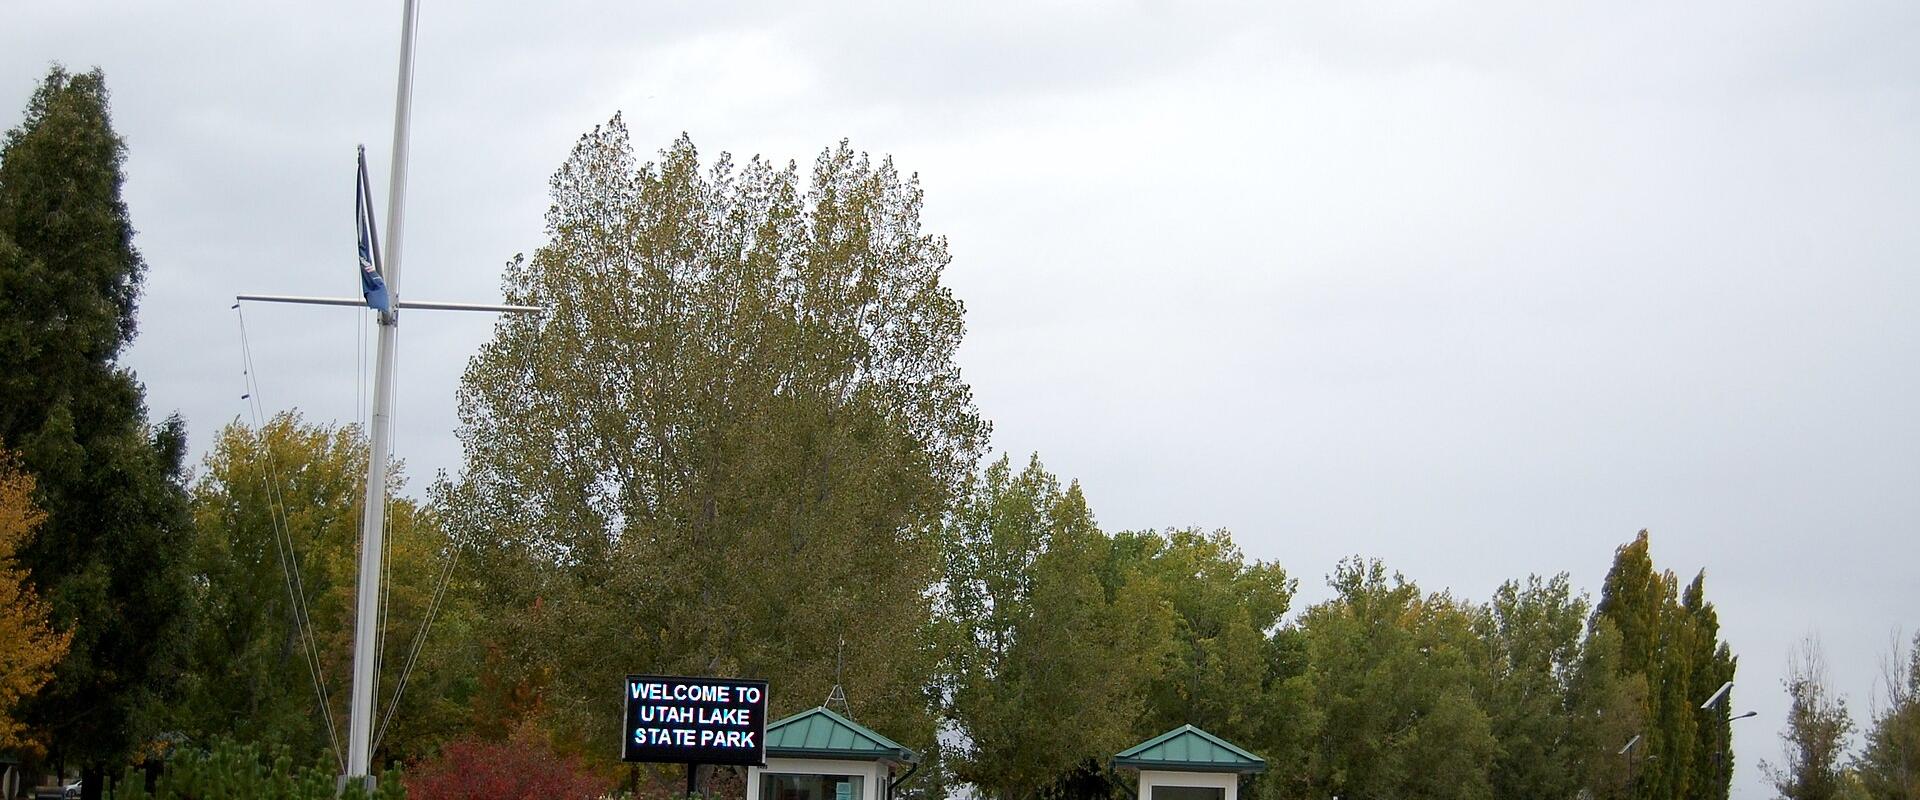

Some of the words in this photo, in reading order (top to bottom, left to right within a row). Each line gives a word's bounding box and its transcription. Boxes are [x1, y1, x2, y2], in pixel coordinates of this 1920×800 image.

[632, 683, 730, 702] WELCOME
[736, 687, 760, 703] TO
[641, 706, 693, 723] UTAH
[699, 708, 750, 725] LAKE
[635, 728, 696, 745] STATE
[701, 731, 755, 747] PARK
